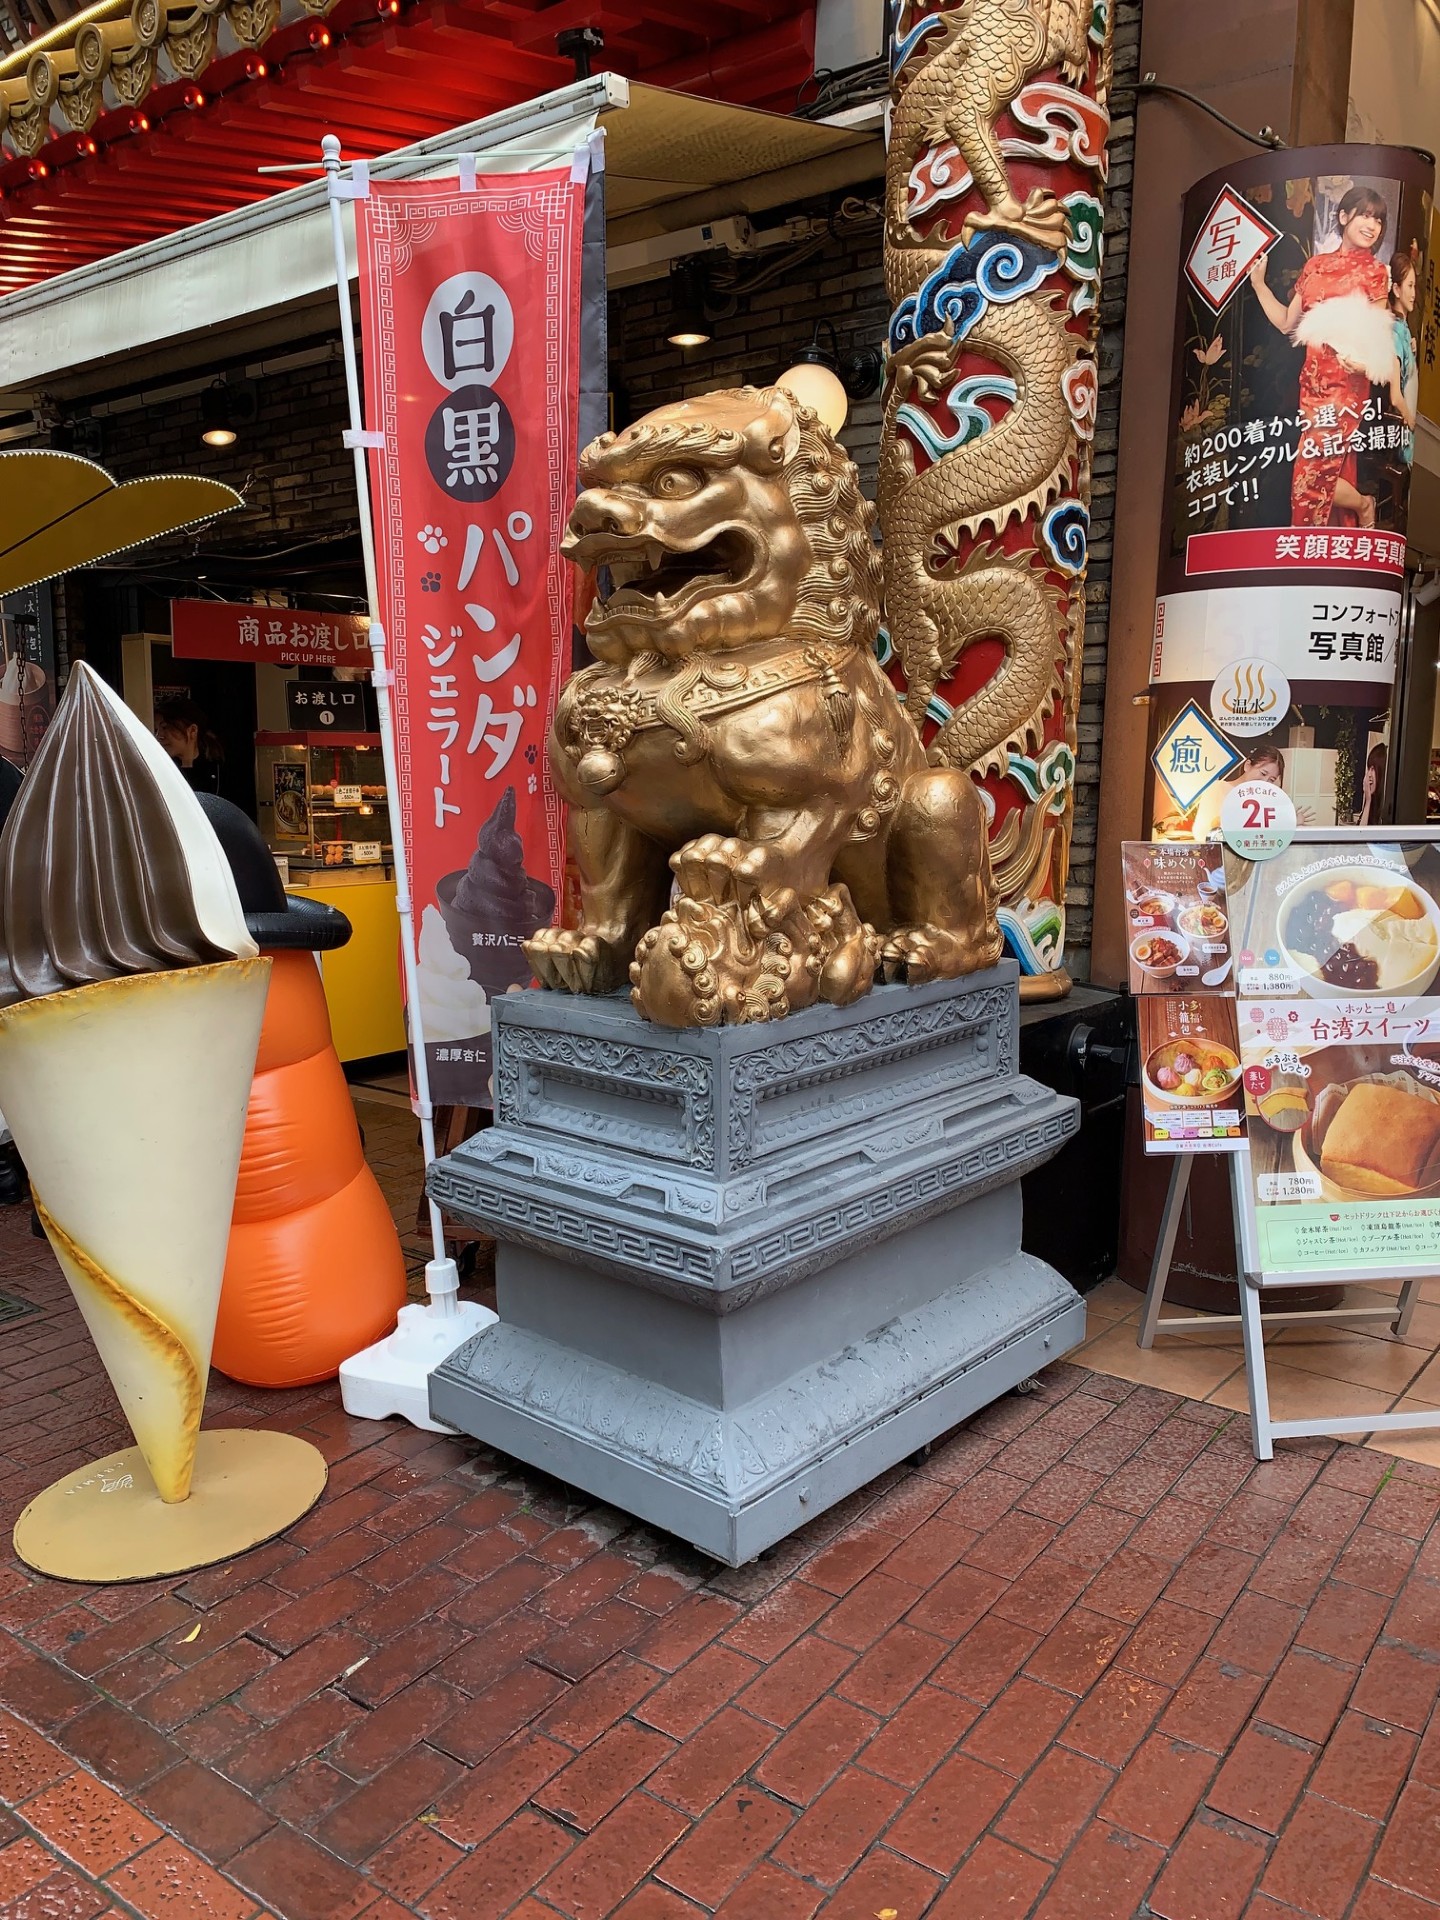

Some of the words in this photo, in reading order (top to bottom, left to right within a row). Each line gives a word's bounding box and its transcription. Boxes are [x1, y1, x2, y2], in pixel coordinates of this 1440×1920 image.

[1206, 214, 1242, 262] 写
[1205, 258, 1237, 286] 真館
[237, 615, 369, 651] 商品お渡し口
[281, 652, 300, 662] PICK
[302, 653, 314, 663] UP
[315, 654, 337, 664] HERE
[294, 691, 356, 706] お渡し口
[1232, 698, 1265, 715] 温水
[420, 623, 464, 829] ジェラート
[1241, 798, 1276, 828] 2F
[1153, 856, 1196, 870] 味めぐり
[1310, 1016, 1431, 1041] 台湾スイーツ
[1343, 1208, 1440, 1220] セットドリンクは下記からお選びく
